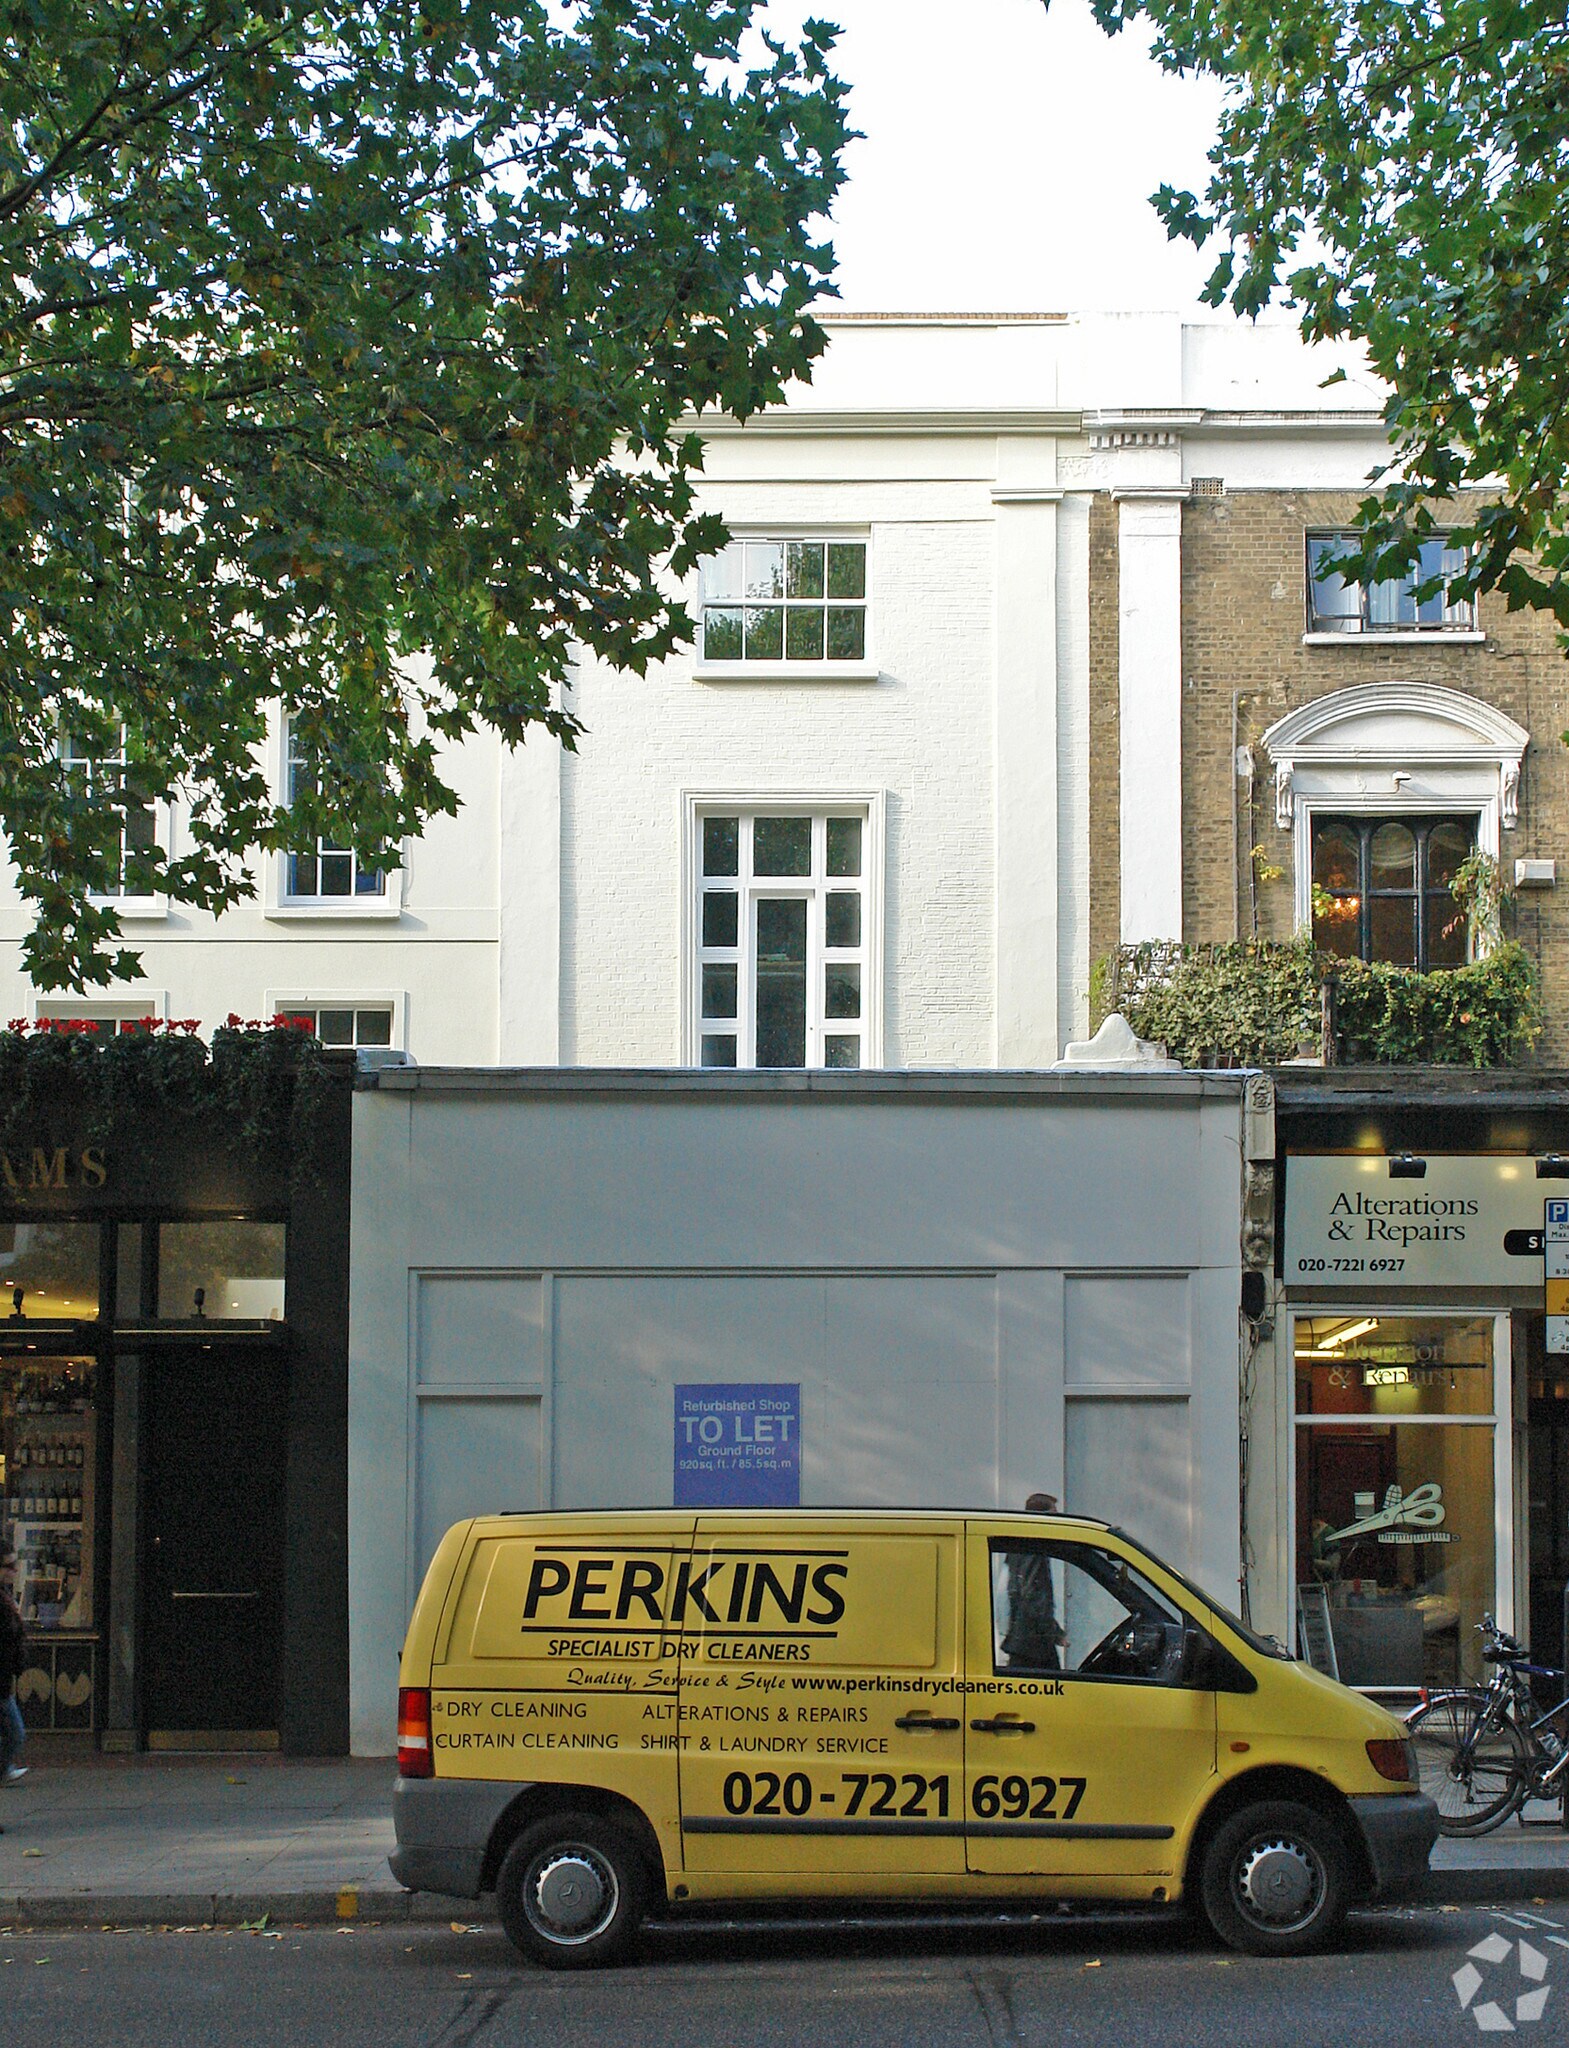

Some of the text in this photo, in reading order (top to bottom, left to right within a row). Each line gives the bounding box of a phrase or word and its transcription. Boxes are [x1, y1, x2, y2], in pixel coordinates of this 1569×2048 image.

[1329, 1191, 1479, 1216] Alterations
[1552, 1203, 1566, 1222] P
[1327, 1217, 1466, 1248] & Repairs
[1528, 1236, 1545, 1249] S
[1298, 1258, 1405, 1272] 020-7221 6927
[1328, 1362, 1448, 1393] & Repairs
[683, 1399, 791, 1412] Refurbished Shop
[679, 1415, 795, 1443] TO LET
[698, 1444, 776, 1456] Ground Floor
[522, 1559, 848, 1625] PERKINS
[547, 1639, 811, 1661] SPECIALIST DRY CLEANERS
[566, 1667, 787, 1694] Quality, Service & Style
[791, 1675, 1065, 1697] www.perkinsdrycleaners.co.uk
[446, 1702, 588, 1718] DRY CLEANING
[642, 1704, 869, 1723] ALTERATIONS & REPAIRS
[434, 1733, 619, 1749] CURTAIN CLEANING
[640, 1734, 889, 1753] SHIRT & LAUNDRY SERVICE
[723, 1771, 1087, 1820] 020-7221 6927
